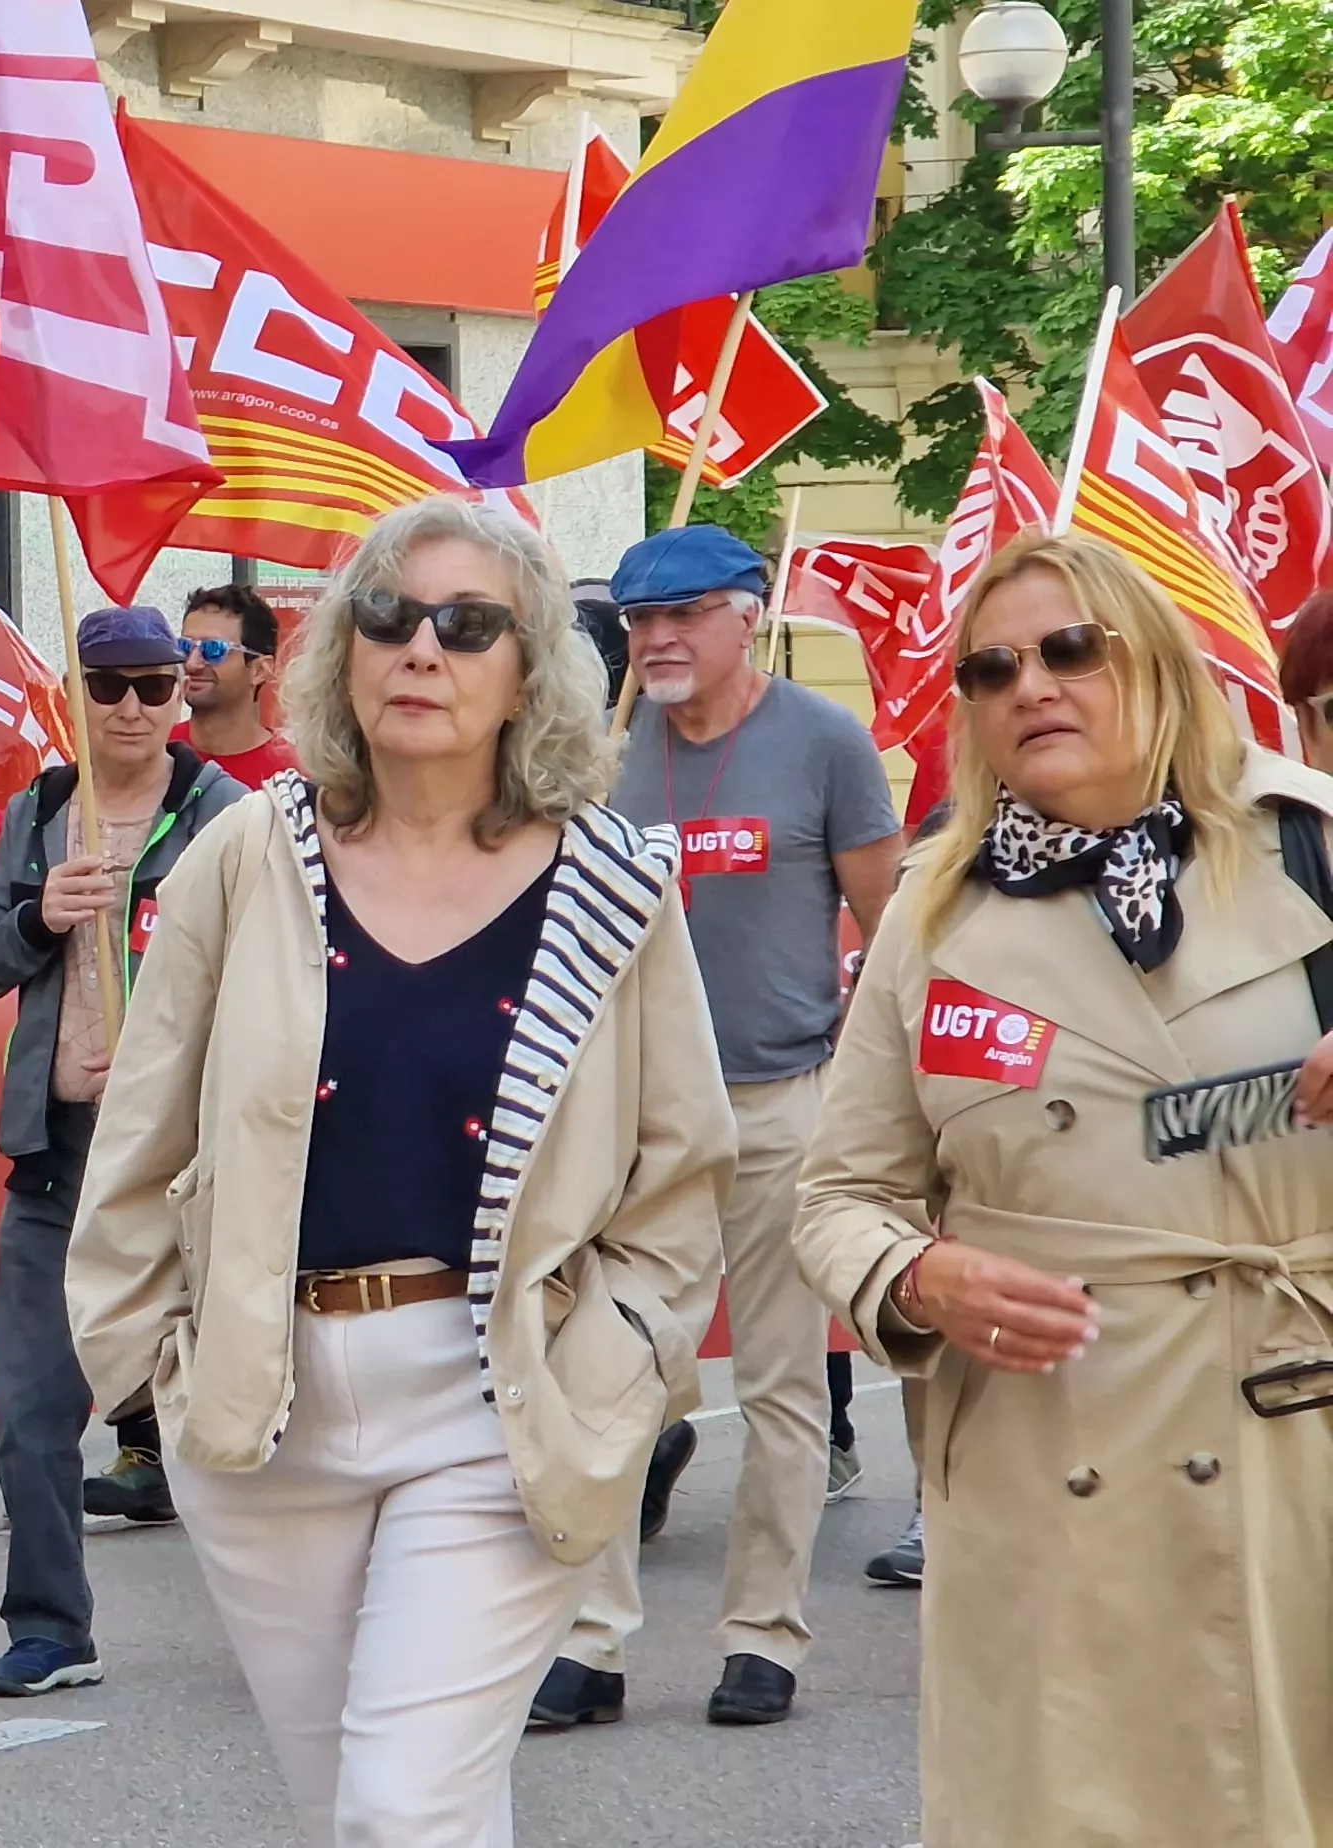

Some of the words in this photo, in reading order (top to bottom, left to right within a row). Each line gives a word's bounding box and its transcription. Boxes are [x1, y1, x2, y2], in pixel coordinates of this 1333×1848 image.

[685, 830, 732, 852] UGT
[930, 1003, 998, 1040] UGT
[984, 1046, 1033, 1067] Aragón
